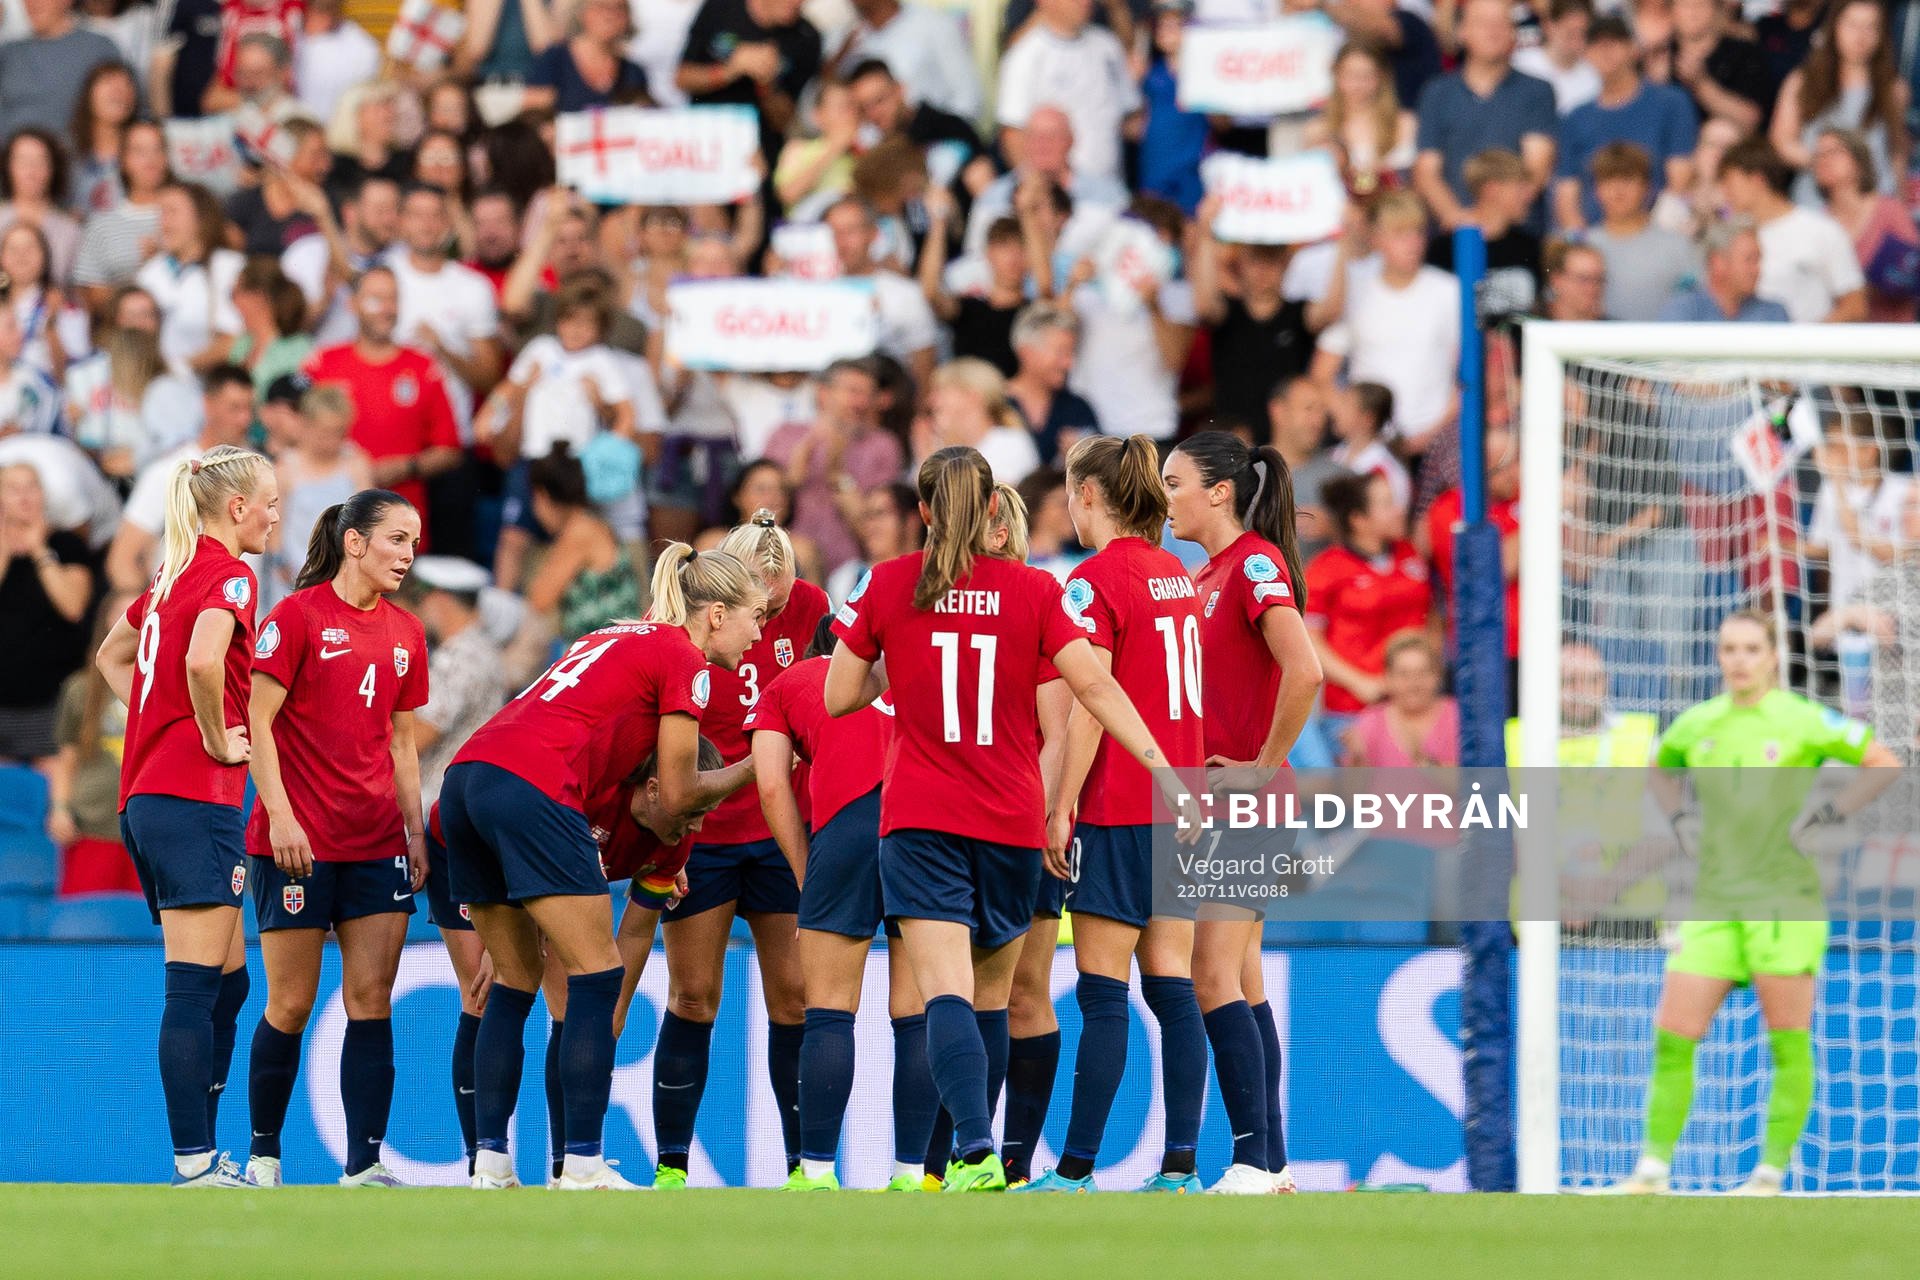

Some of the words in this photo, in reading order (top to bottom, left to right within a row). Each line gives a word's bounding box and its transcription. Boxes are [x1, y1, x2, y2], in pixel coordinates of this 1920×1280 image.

[714, 305, 829, 340] GOAL!
[137, 611, 160, 714] 9
[738, 663, 759, 706] 3
[1154, 614, 1203, 721] 10
[358, 663, 376, 708] 4
[931, 632, 997, 746] 11
[395, 855, 408, 880] 4
